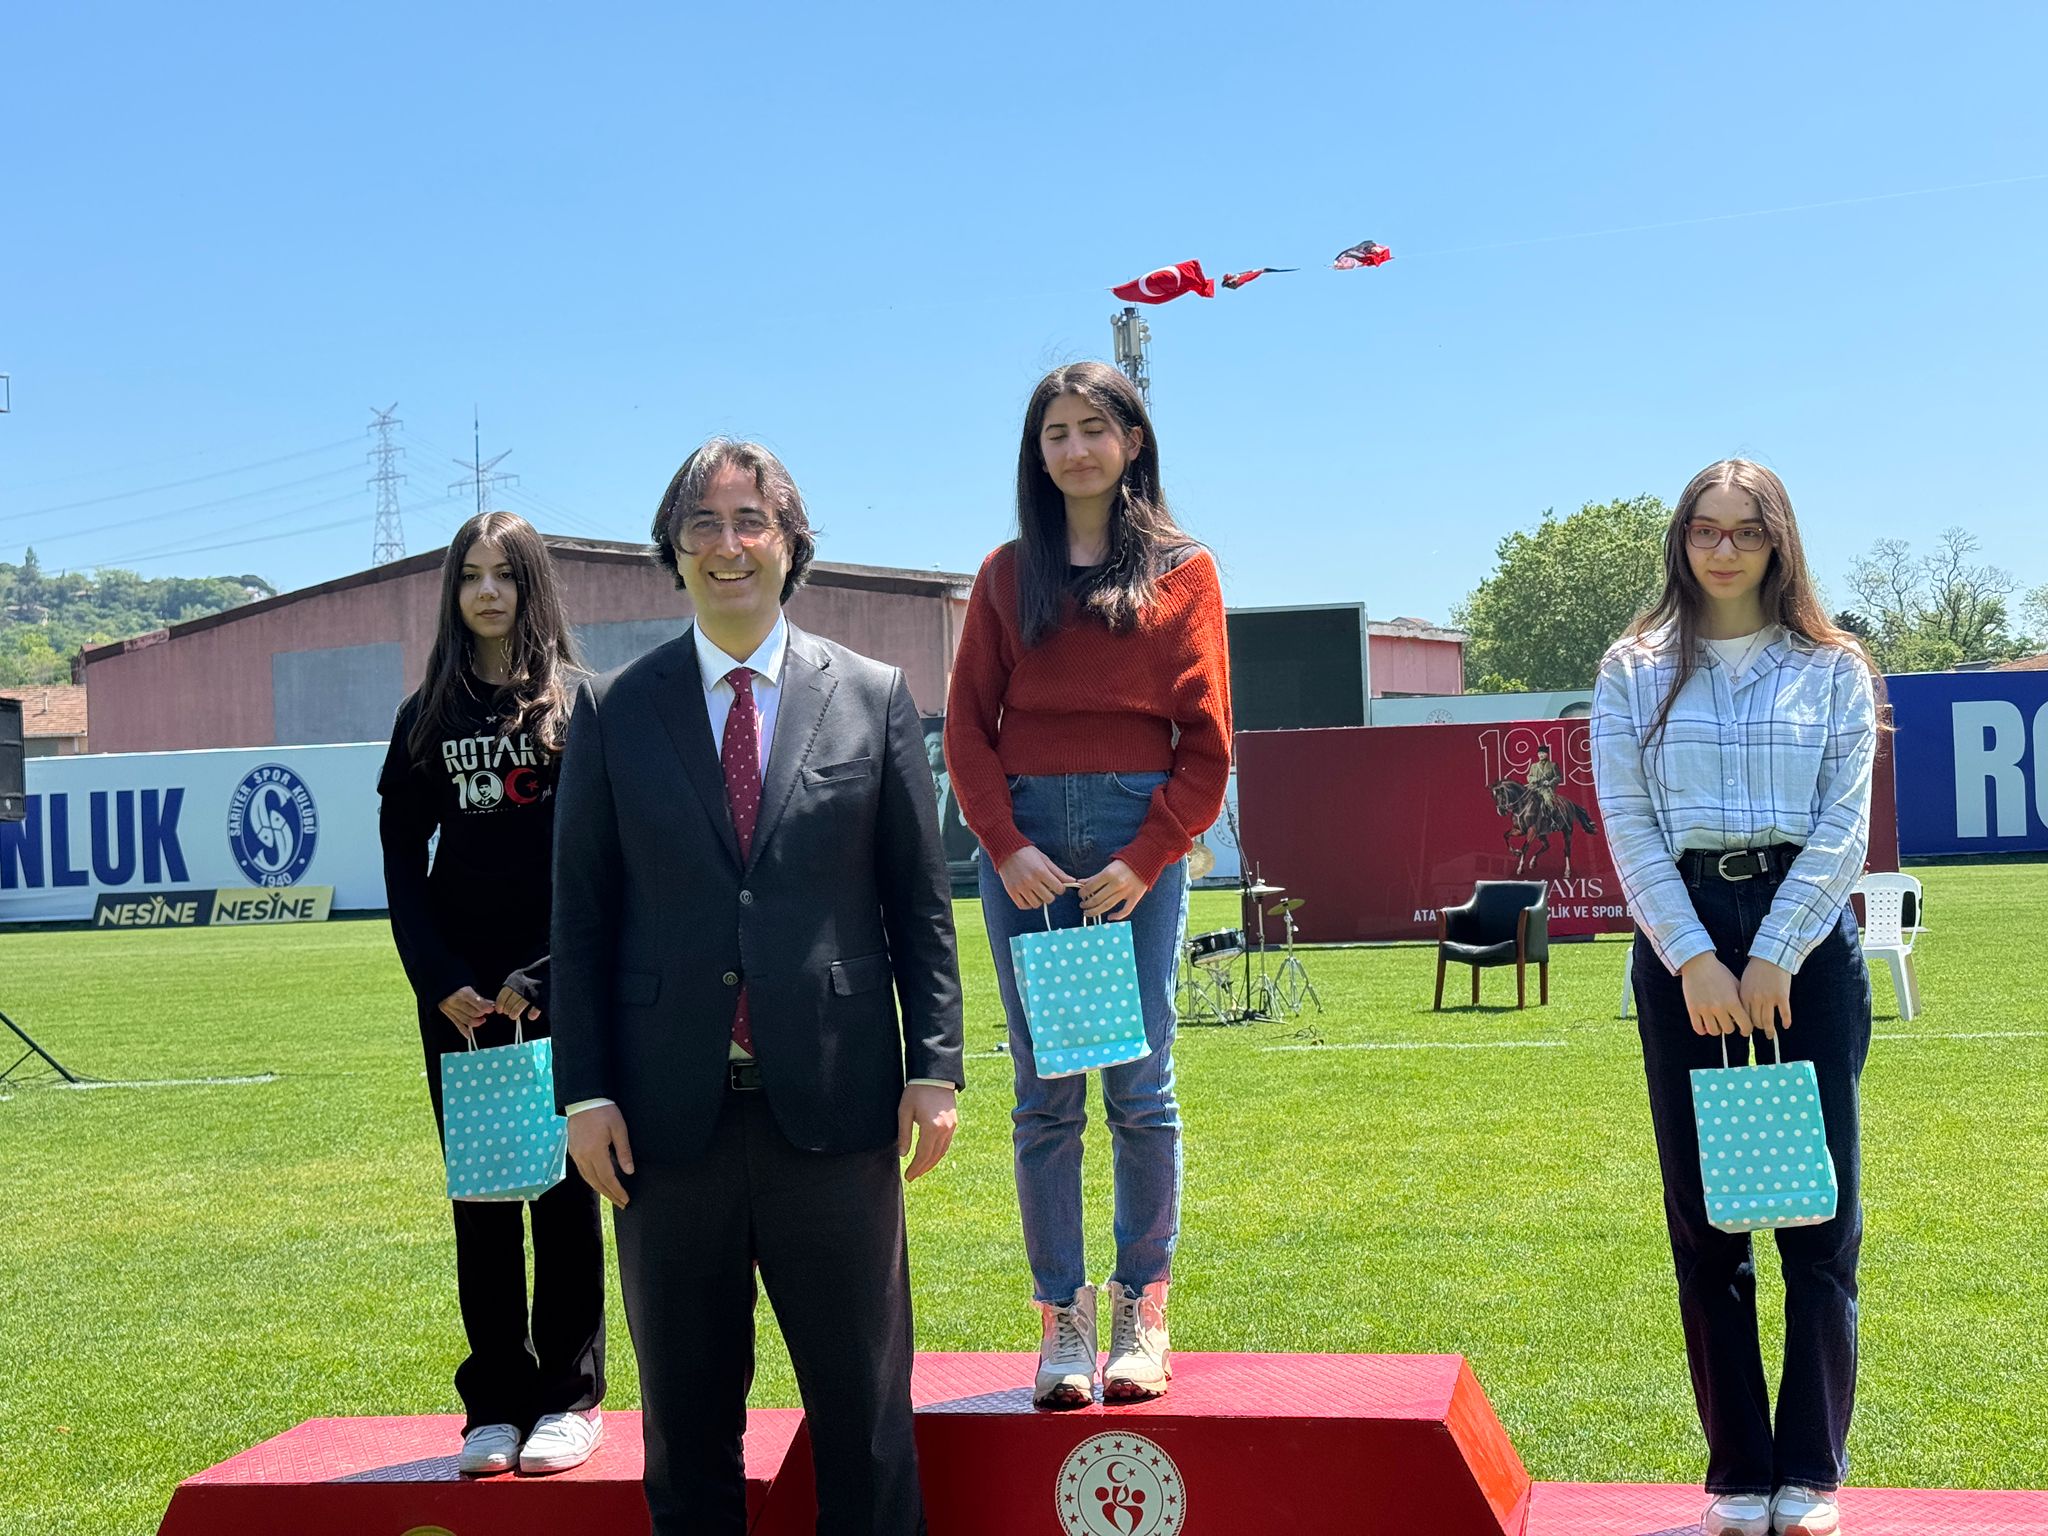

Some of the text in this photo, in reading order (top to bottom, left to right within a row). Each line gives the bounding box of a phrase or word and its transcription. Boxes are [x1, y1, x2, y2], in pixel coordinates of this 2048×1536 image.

[1952, 700, 2048, 838] R
[229, 784, 251, 837] SARIYER
[253, 769, 291, 785] SPOR
[259, 872, 293, 887] 1940
[1547, 878, 1604, 898] AYIS
[1573, 905, 1589, 918] VE
[1592, 904, 1624, 918] SPOR
